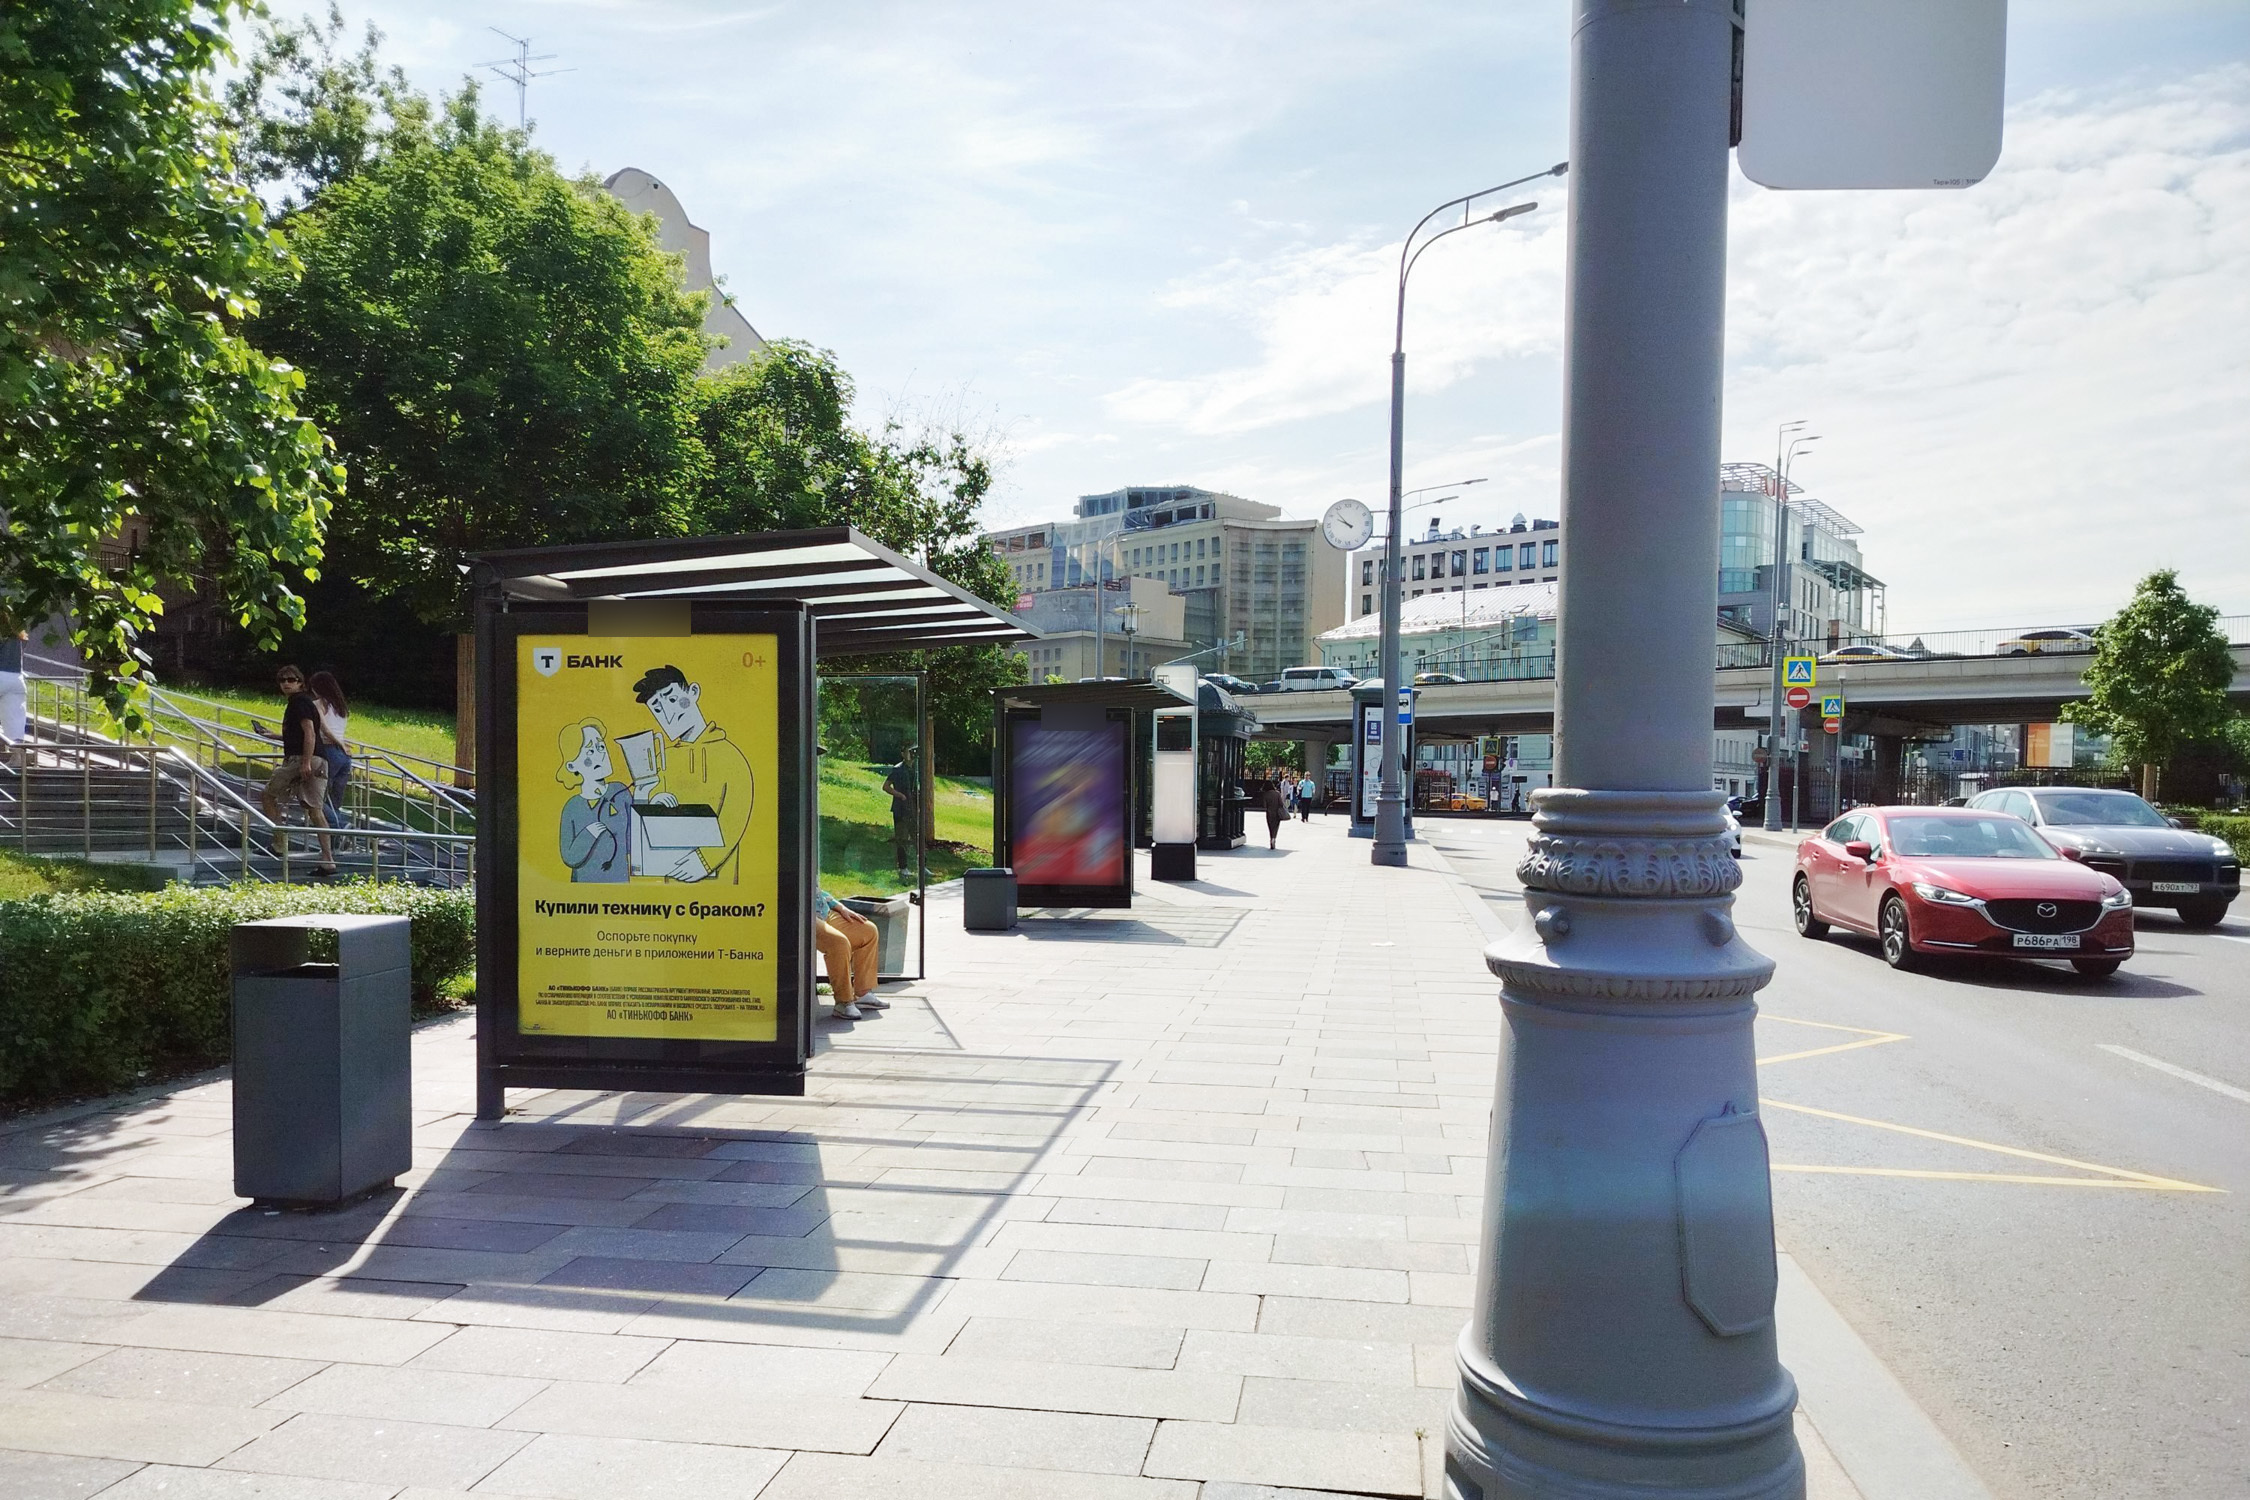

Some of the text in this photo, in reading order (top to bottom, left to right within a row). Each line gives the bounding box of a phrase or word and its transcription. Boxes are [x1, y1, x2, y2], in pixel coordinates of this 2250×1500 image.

[566, 654, 624, 669] БАНК
[742, 651, 767, 668] 0+
[535, 899, 766, 920] Купили технику с браком?
[596, 930, 698, 946] Оспорьте покупку
[2061, 935, 2077, 944] 198
[535, 947, 765, 961] и верните деньги в приложении Т-Банка
[606, 1009, 694, 1022] АО «ТИНЬКОФФ БАНК»
